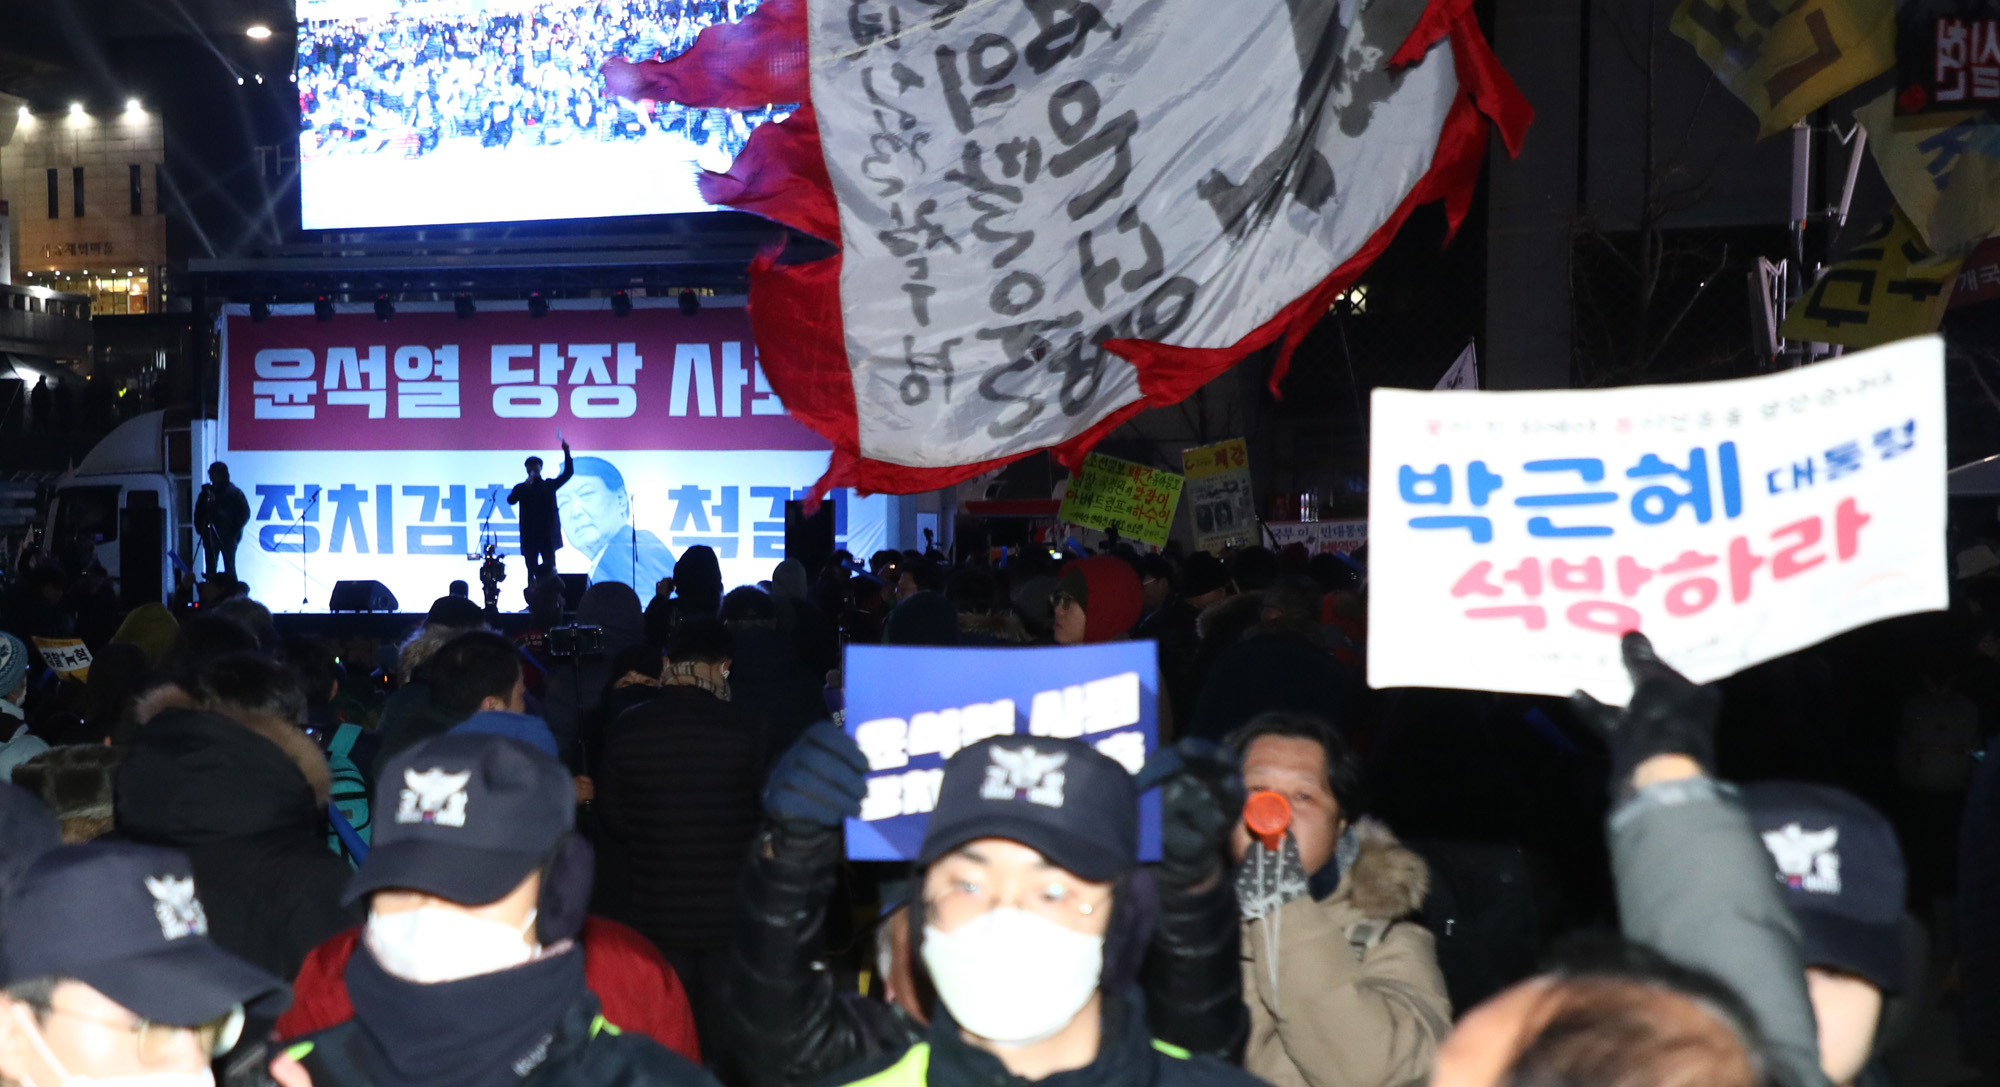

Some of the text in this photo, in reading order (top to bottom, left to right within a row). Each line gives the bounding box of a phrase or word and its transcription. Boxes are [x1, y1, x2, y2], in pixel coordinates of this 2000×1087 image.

[252, 343, 461, 421] 윤석열
[490, 341, 643, 420] 당장
[1397, 419, 1918, 544] 박근혜 대통령
[1451, 496, 1872, 635] 석방하라
